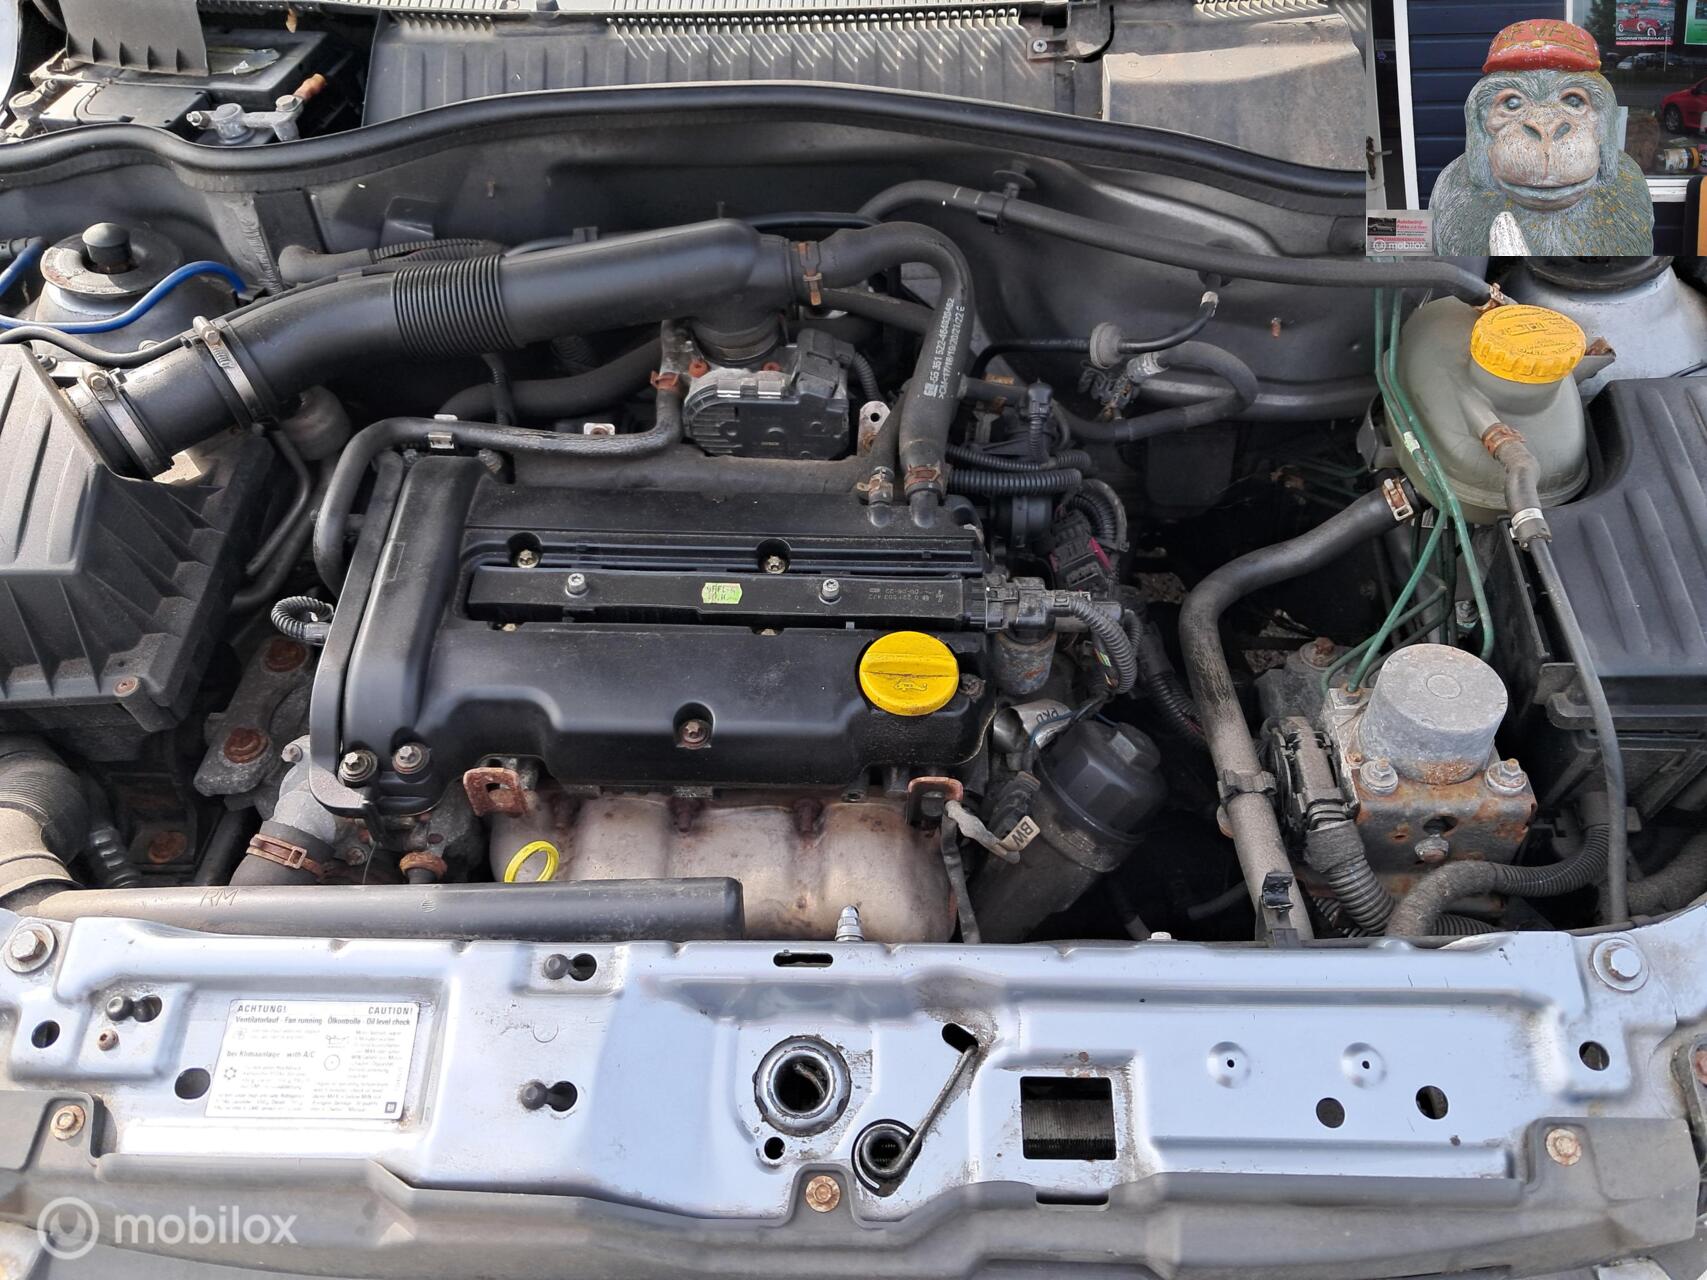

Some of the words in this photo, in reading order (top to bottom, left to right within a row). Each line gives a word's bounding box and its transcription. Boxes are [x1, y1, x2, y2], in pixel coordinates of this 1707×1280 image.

[1011, 820, 1034, 848] BW
[237, 1004, 287, 1013] ACHTUNG!
[367, 1006, 413, 1015] CAUTION!
[235, 1015, 279, 1024] Ventilatorlauf
[297, 1018, 323, 1026] running
[327, 1016, 361, 1025] Ölkontrolle
[366, 1017, 376, 1026] Oil
[376, 1017, 390, 1026] level
[390, 1018, 411, 1026] check
